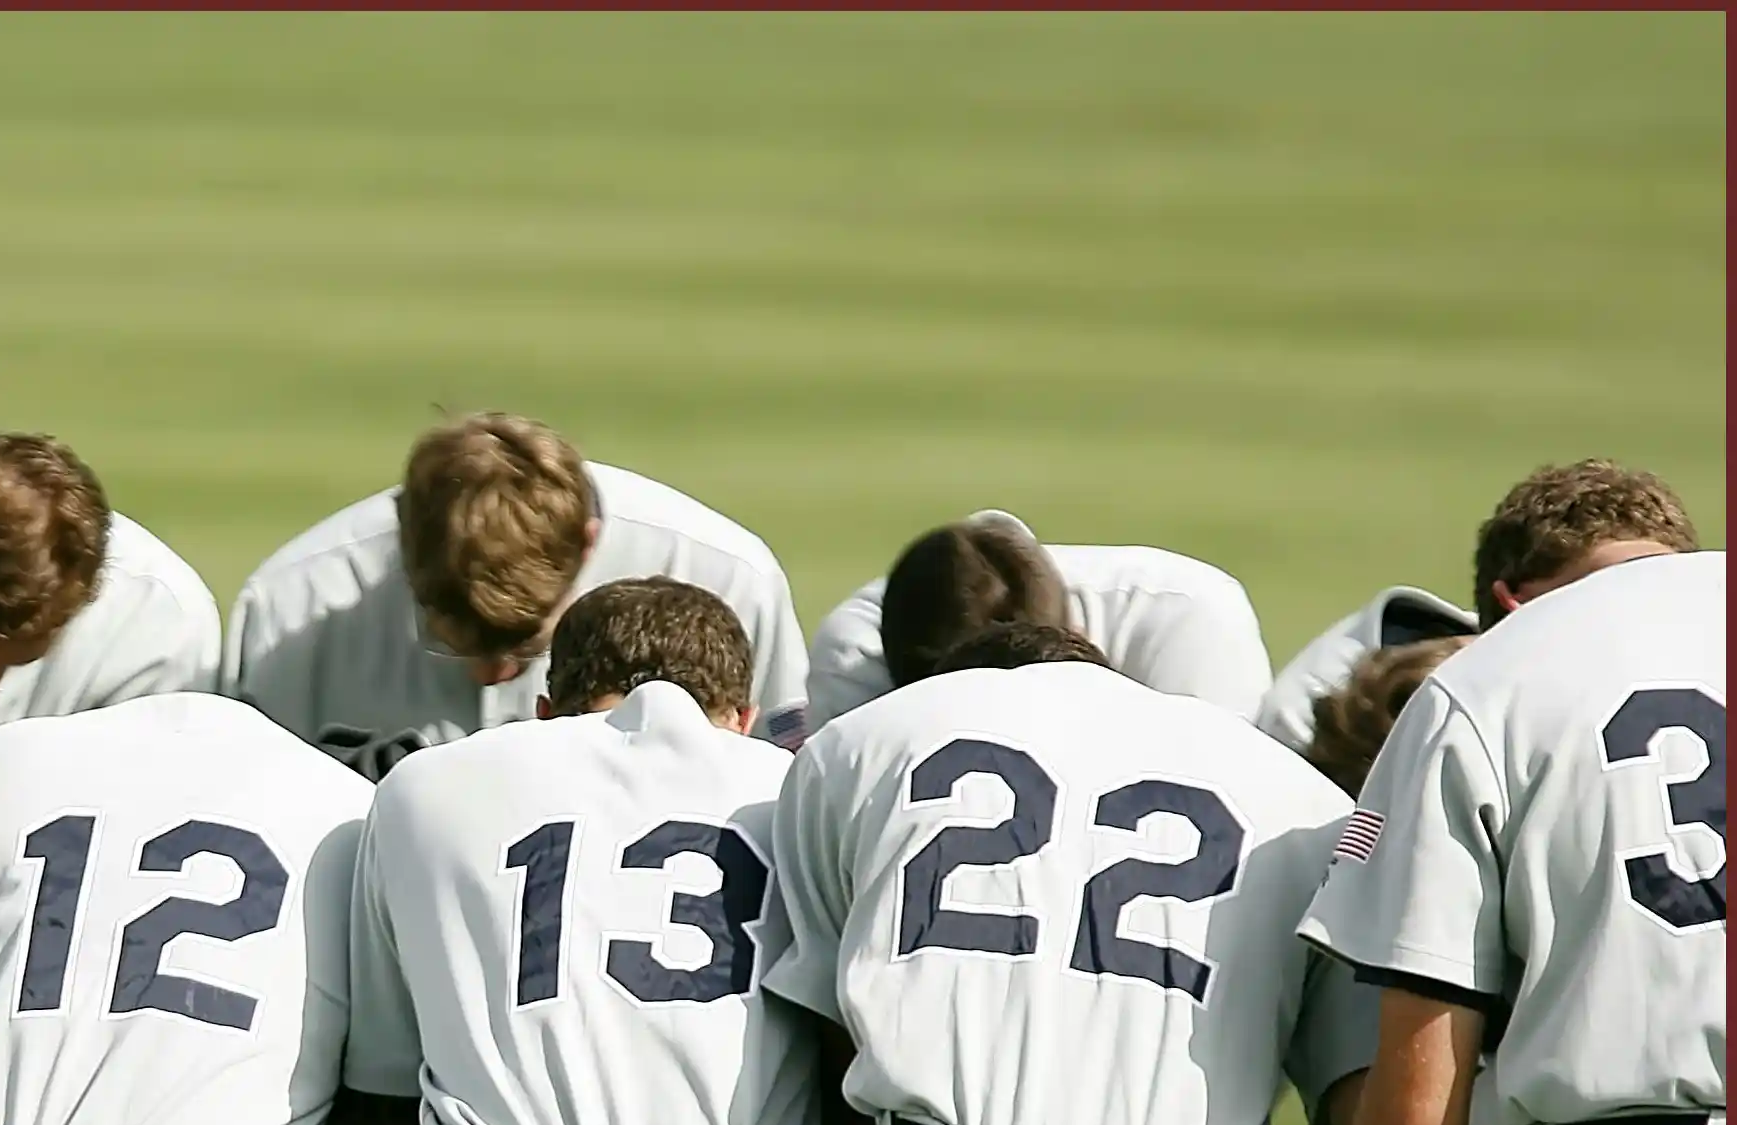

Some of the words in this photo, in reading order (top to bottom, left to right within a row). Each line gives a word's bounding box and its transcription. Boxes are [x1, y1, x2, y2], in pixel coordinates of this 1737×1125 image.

[21, 811, 292, 1032] 12
[501, 816, 773, 1009] 13
[894, 735, 1251, 1005] 22
